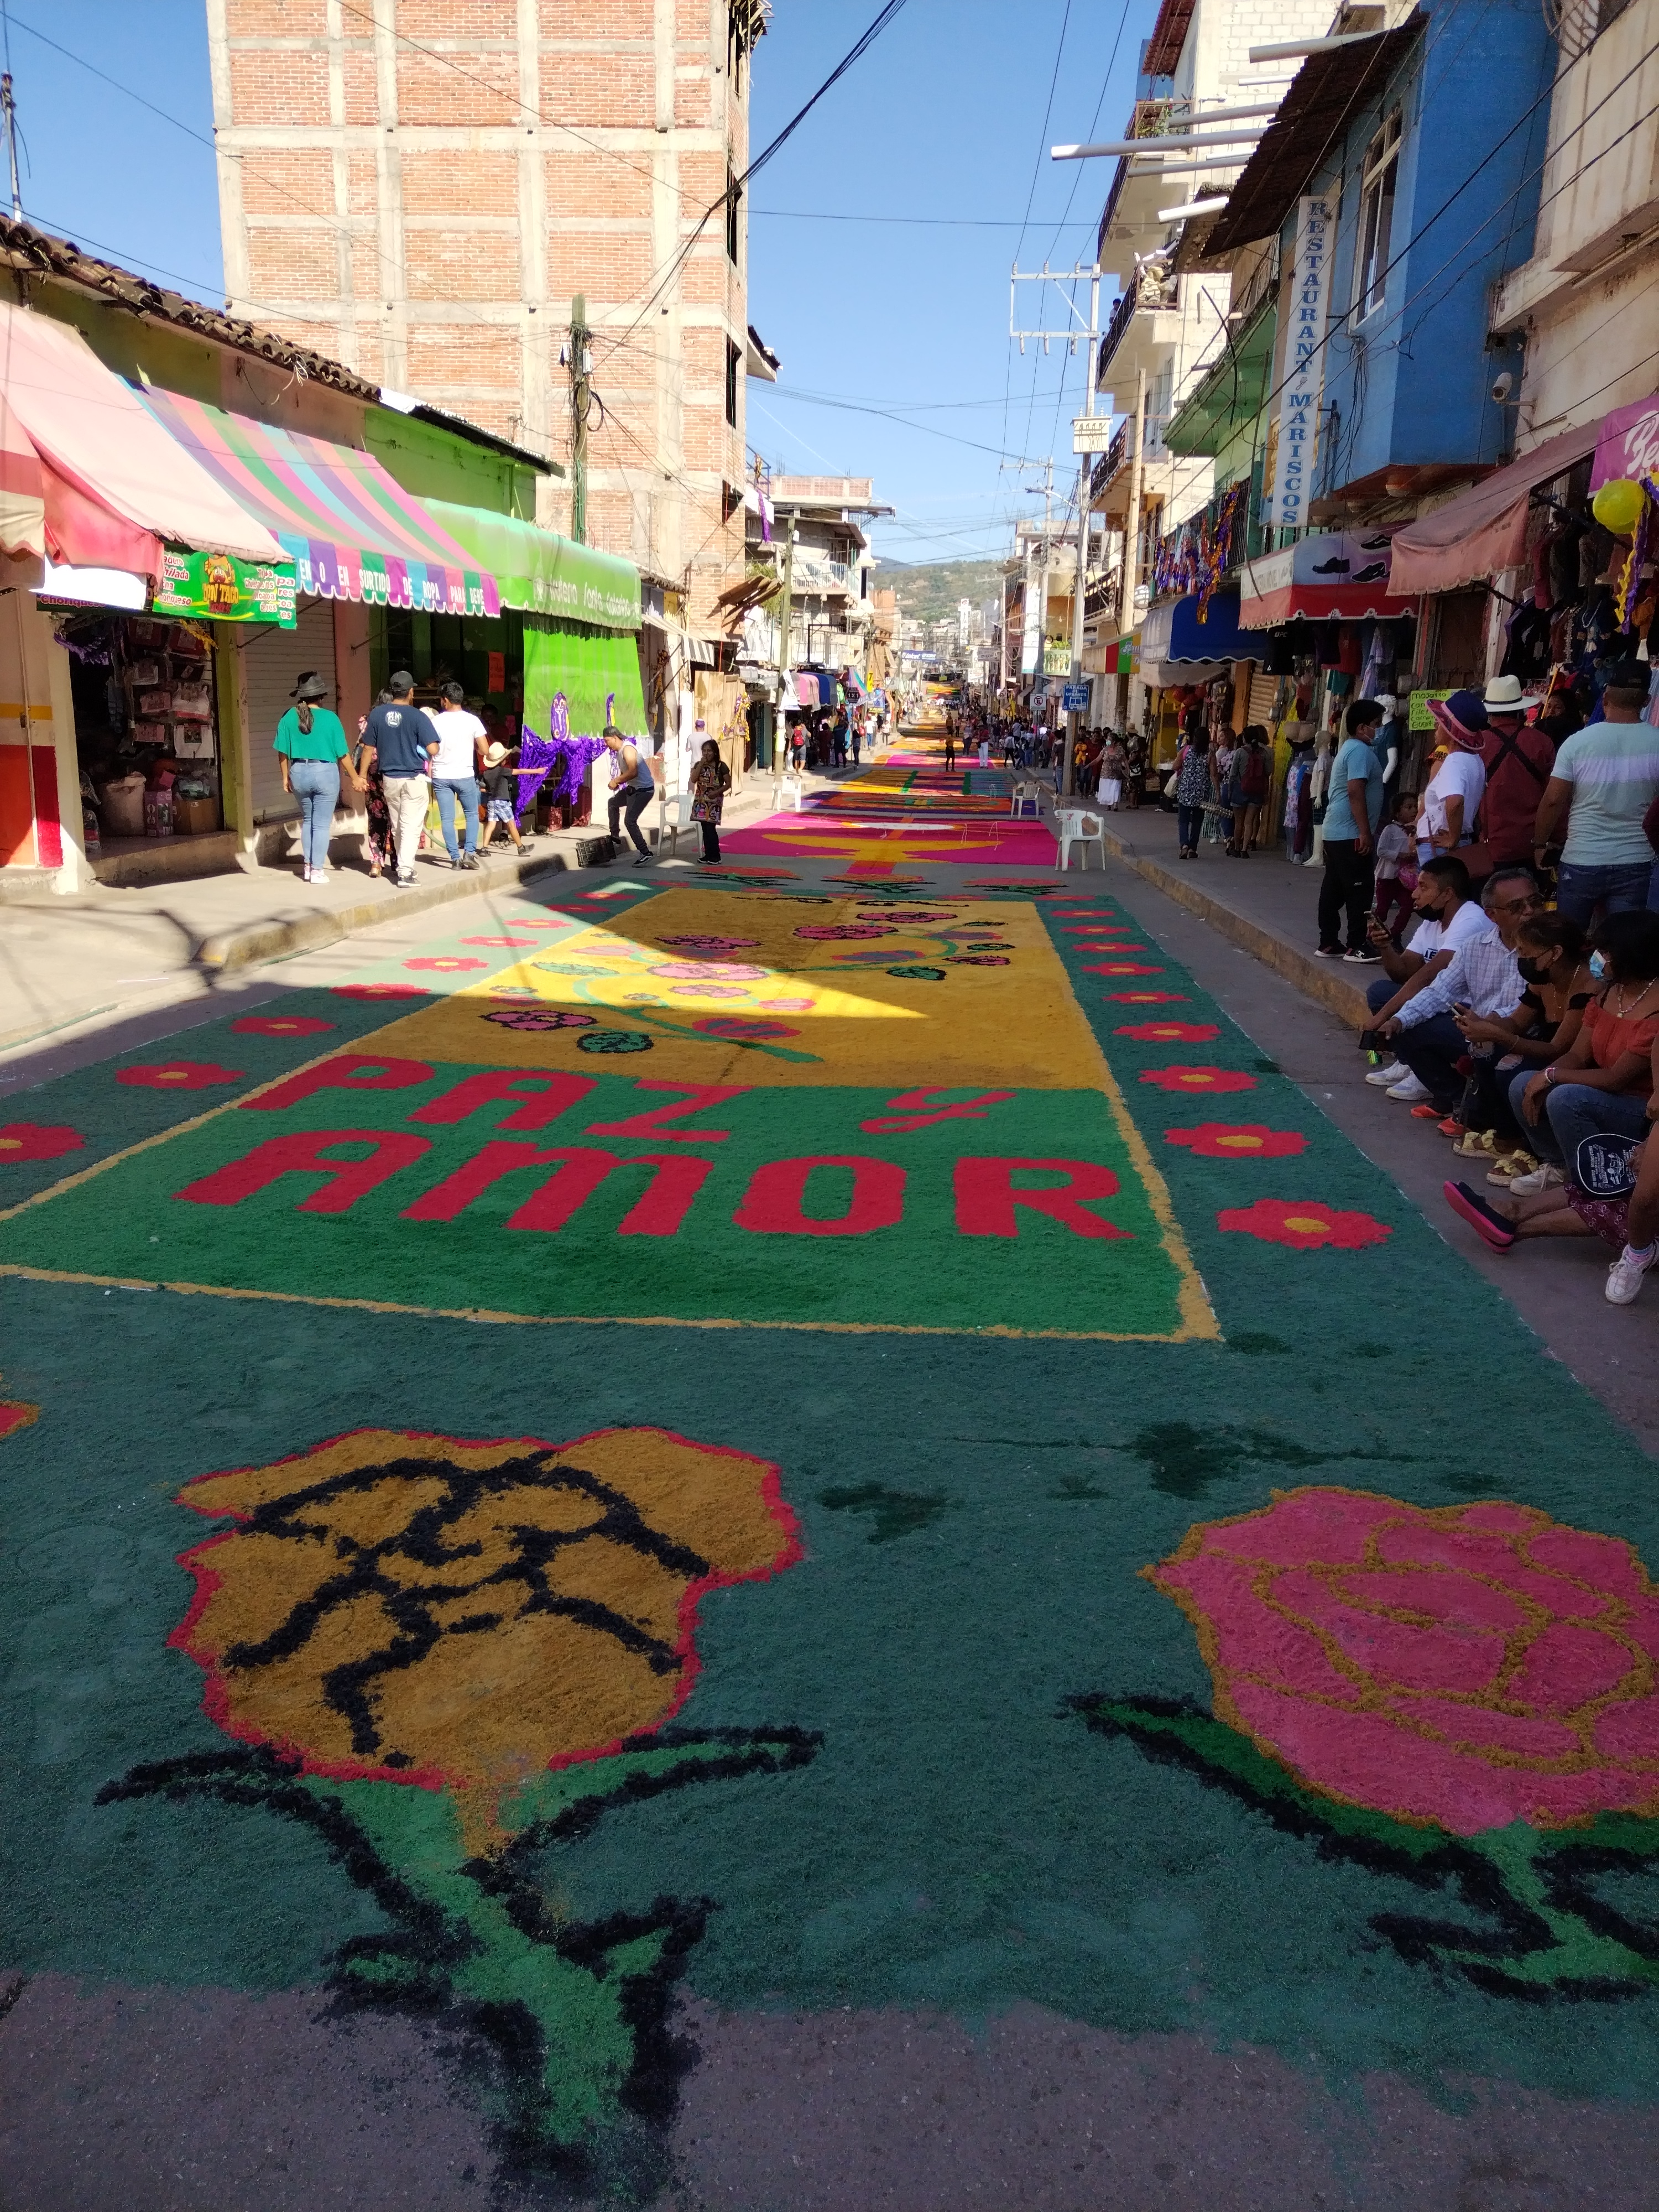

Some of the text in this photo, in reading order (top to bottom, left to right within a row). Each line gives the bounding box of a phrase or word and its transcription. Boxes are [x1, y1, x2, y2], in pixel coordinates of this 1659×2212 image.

[1281, 201, 1327, 524] RESTAURANT MARISCOS
[220, 584, 239, 604] TACO
[358, 569, 391, 593] SURTIDO
[402, 576, 413, 596] DE
[422, 580, 440, 601] ROPA
[450, 585, 466, 604] PARA
[469, 587, 485, 606] BEBE
[237, 1054, 753, 1143] PAZ
[171, 1128, 1138, 1239] AMOR
